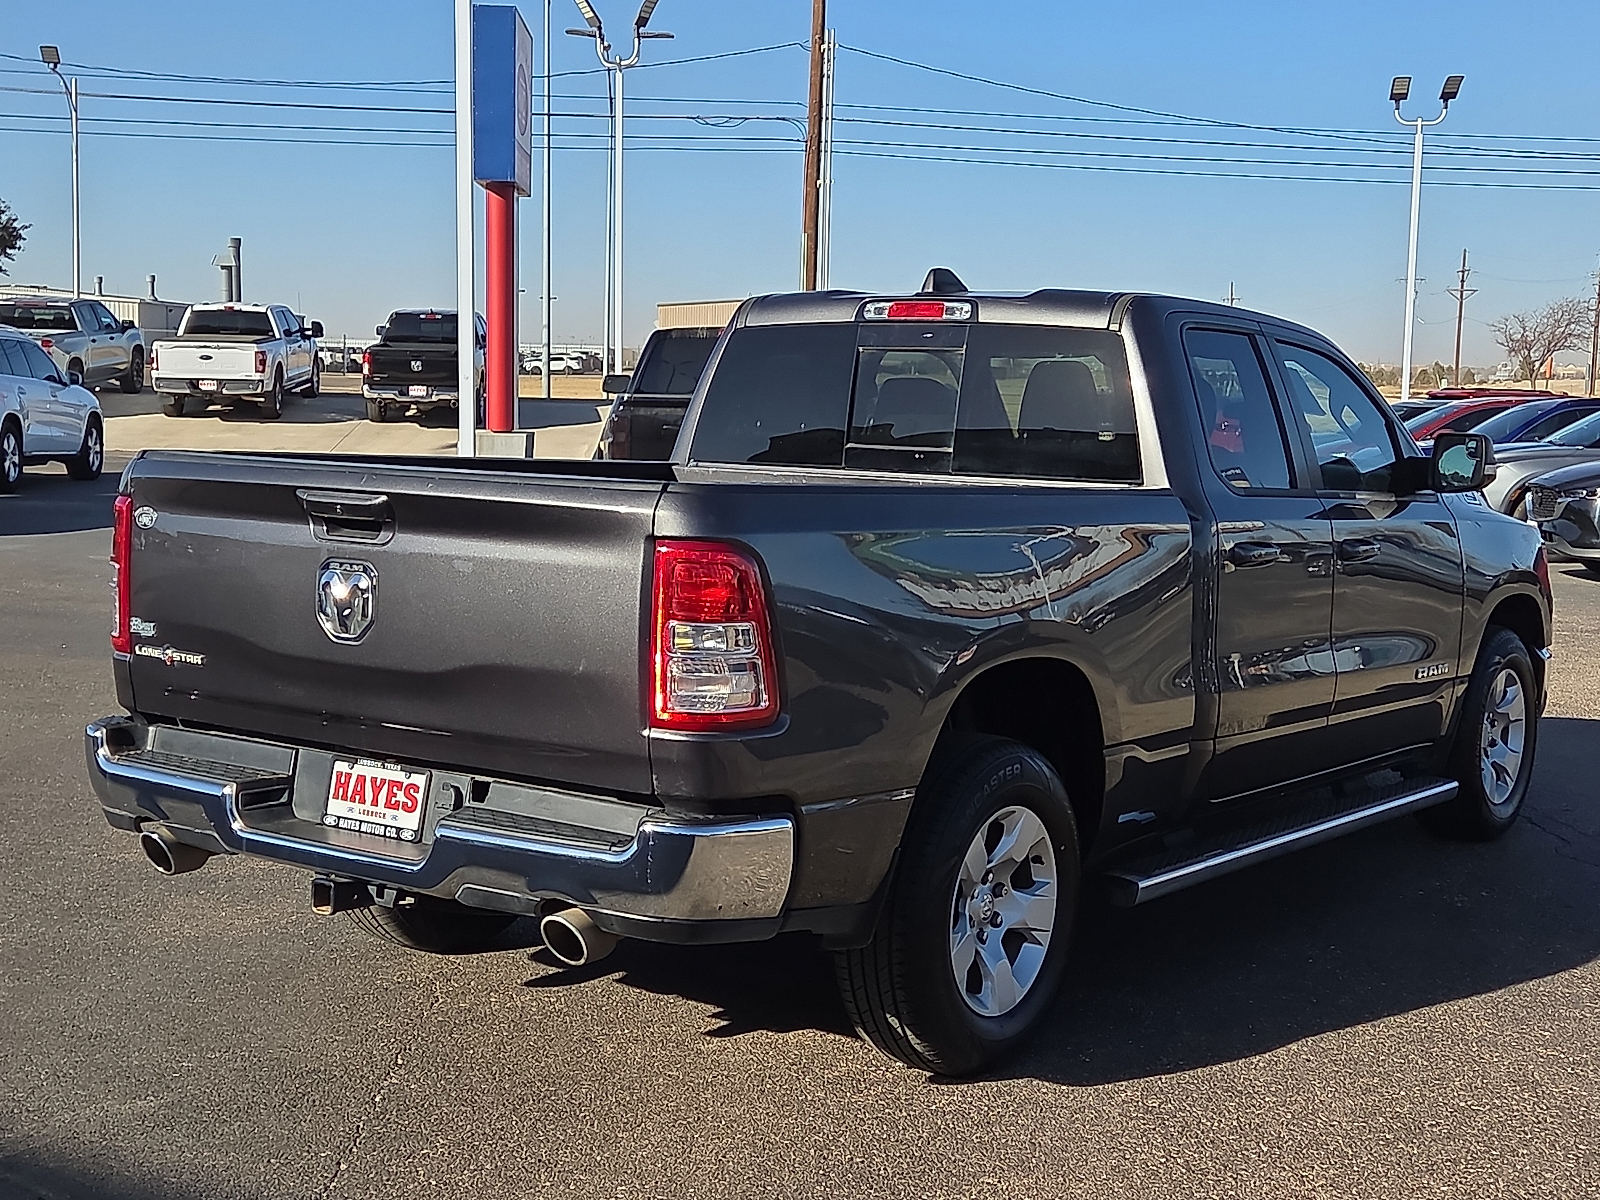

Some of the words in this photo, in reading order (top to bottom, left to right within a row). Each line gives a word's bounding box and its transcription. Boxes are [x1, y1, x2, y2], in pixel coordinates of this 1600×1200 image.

[328, 562, 363, 571] RAM
[135, 643, 163, 658] LONE
[172, 652, 205, 665] STAR
[1416, 663, 1449, 679] RAM
[332, 771, 420, 813] HAYES
[358, 809, 387, 819] LUBBOCK
[339, 818, 360, 831] HAYES
[360, 822, 385, 835] MOTOR
[385, 827, 398, 838] CO.
